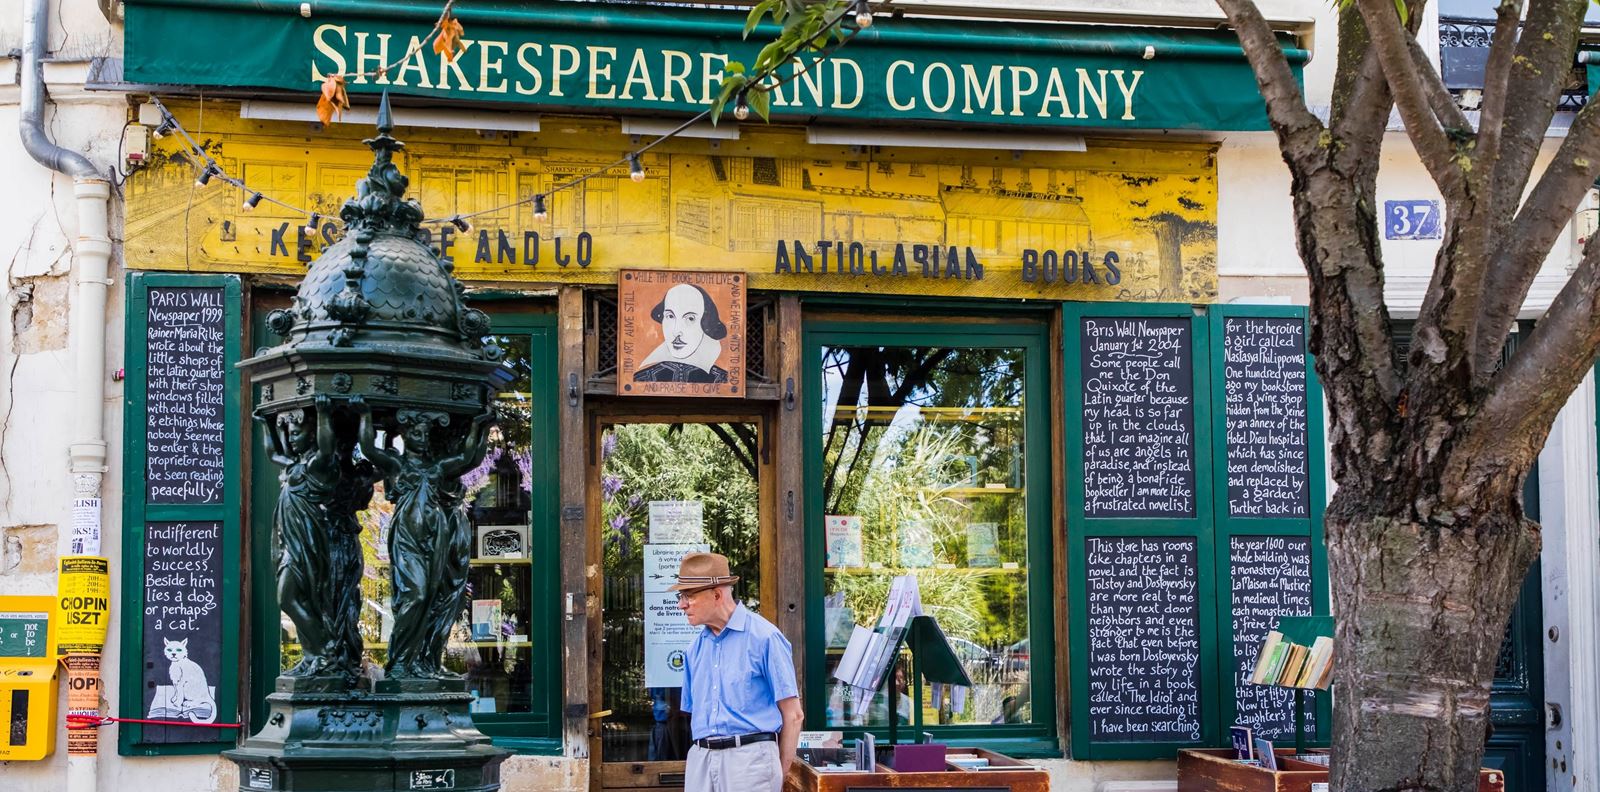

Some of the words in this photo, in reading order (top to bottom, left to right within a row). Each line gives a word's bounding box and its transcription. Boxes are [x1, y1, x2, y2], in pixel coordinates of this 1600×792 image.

[311, 24, 729, 105] SHAKESPEARE
[763, 56, 864, 109] AND
[886, 60, 1145, 121] COMPANY
[1393, 205, 1432, 235] 37
[475, 230, 539, 265] AND
[1023, 249, 1122, 285] BOOKS
[634, 272, 652, 283] WHILE
[657, 273, 668, 283] THY
[672, 273, 692, 283] BOOKE
[716, 274, 731, 285] LIVE
[731, 284, 740, 297] AND
[151, 291, 187, 306] PARIS
[191, 293, 223, 307] WALL
[624, 291, 634, 312] STILL
[149, 308, 200, 326] Newspaper
[201, 308, 222, 323] 1999
[148, 327, 174, 339] Rainer
[174, 327, 197, 340] Maria
[198, 326, 223, 341] Rilke
[624, 317, 634, 337] ALIVE
[1086, 321, 1113, 337] Paris
[1115, 321, 1135, 337] Wall
[1138, 320, 1184, 344] Newspaper
[1226, 319, 1241, 334] for
[1246, 320, 1263, 334] the
[1266, 320, 1302, 334] heroine
[148, 339, 175, 350] wrote
[179, 341, 204, 353] about
[208, 342, 223, 354] the
[624, 342, 633, 355] ART
[1090, 339, 1129, 354] January
[1132, 338, 1143, 352] 1st
[1148, 337, 1181, 354] 2004
[1225, 336, 1231, 346] a
[1234, 335, 1256, 352] girl
[1259, 335, 1294, 349] called
[149, 352, 175, 364] little
[179, 354, 208, 368] shops
[211, 355, 223, 371] of
[1090, 354, 1121, 368] Some
[1126, 357, 1160, 374] people
[1164, 356, 1180, 368] call
[148, 365, 164, 375] the
[167, 365, 188, 376] latin
[189, 367, 224, 382] quarter
[149, 377, 168, 388] with
[172, 378, 197, 390] their
[199, 380, 223, 396] shop
[643, 383, 657, 392] AND
[661, 384, 687, 393] PRAISE
[692, 384, 700, 393] TO
[703, 384, 720, 393] GIVE
[148, 391, 192, 401] windows
[195, 391, 223, 406] filled
[148, 403, 169, 413] with
[171, 403, 185, 414] old
[190, 404, 216, 416] books
[149, 415, 156, 427] &
[200, 417, 224, 430] Where
[148, 430, 181, 446] nobody
[184, 432, 223, 442] seemed
[149, 442, 158, 452] to
[161, 442, 188, 453] enter
[192, 442, 199, 454] &
[203, 444, 222, 455] the
[149, 454, 198, 470] proprietor
[199, 456, 224, 467] could
[149, 467, 161, 480] be
[164, 472, 187, 480] seen
[190, 469, 223, 490] reading
[1092, 496, 1146, 514] frustrated
[1230, 500, 1263, 514] Further
[1266, 500, 1289, 513] back
[1293, 502, 1304, 514] in
[150, 524, 218, 542] indifferent
[147, 543, 159, 557] to
[163, 542, 214, 562] worldly
[1088, 538, 1113, 553] This
[1117, 539, 1138, 553] store
[1142, 539, 1158, 551] has
[1163, 542, 1192, 551] rooms
[1231, 538, 1244, 549] the
[1245, 542, 1265, 553] year
[1266, 537, 1284, 550] 1600
[146, 573, 187, 587] Beside
[191, 572, 214, 587] him
[1088, 577, 1125, 593] Tolstoy
[1127, 576, 1143, 588] and
[1143, 575, 1195, 594] Dostoyevsky
[61, 597, 107, 611] CHOPIN
[147, 588, 169, 602] lies
[175, 591, 182, 602] a
[188, 589, 216, 611] dog
[1232, 593, 1240, 604] In
[1243, 592, 1278, 604] medieval
[1283, 590, 1310, 605] times
[145, 606, 158, 615] or
[163, 601, 210, 619] perhaps
[67, 612, 101, 625] LISZT
[155, 619, 162, 630] a
[24, 623, 39, 631] not
[25, 636, 36, 646] be
[1237, 699, 1257, 711] Now
[1261, 697, 1269, 708] it
[1273, 694, 1283, 707] is
[1094, 721, 1096, 734] I
[1102, 719, 1123, 732] have
[1127, 718, 1148, 732] been
[1152, 717, 1199, 739] searching
